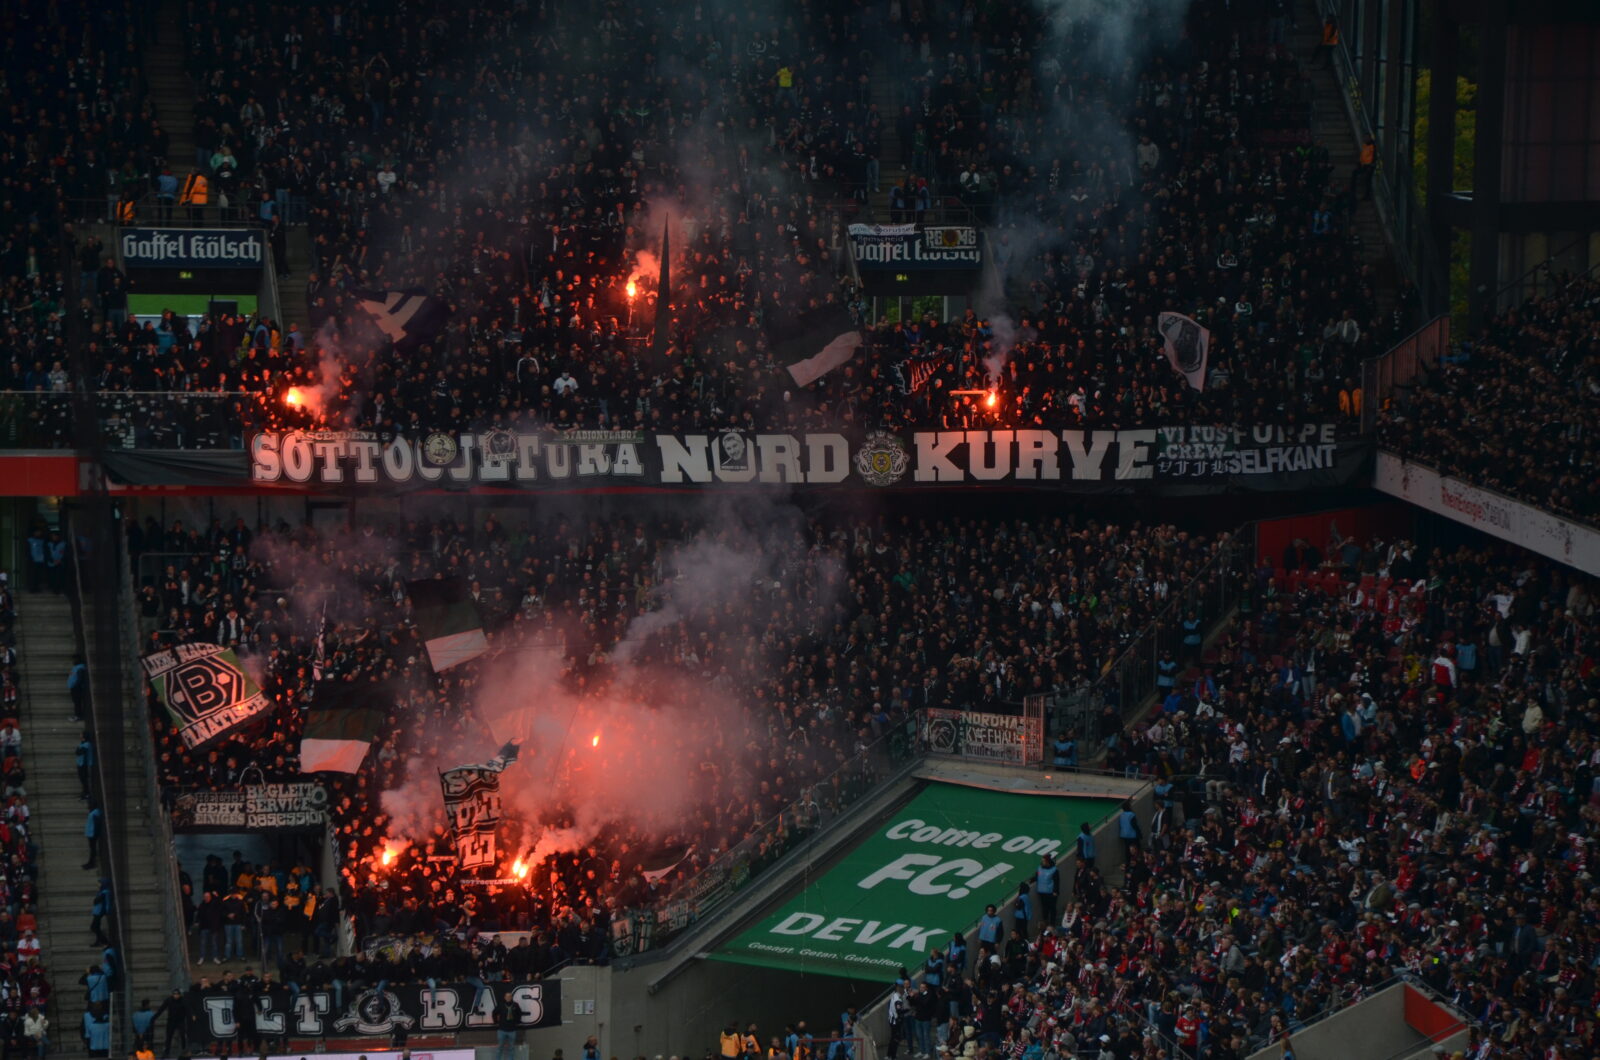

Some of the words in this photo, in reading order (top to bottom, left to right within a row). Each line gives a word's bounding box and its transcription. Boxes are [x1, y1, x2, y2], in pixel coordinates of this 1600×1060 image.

[122, 231, 188, 260] Gaffel
[190, 234, 262, 262] Kölsch
[655, 433, 849, 484] NORD
[913, 429, 1157, 482] KURVE
[1227, 443, 1337, 475] SELFKANT
[194, 813, 246, 825] EINIGES
[195, 802, 244, 814] GEHT
[245, 799, 311, 813] SERVICE
[885, 818, 1003, 849] Come
[857, 853, 1015, 900] FC!
[769, 911, 949, 953] DEVK
[748, 941, 795, 955] Gesagt.
[799, 948, 839, 961] Getan.
[843, 953, 904, 968] Geholfen.
